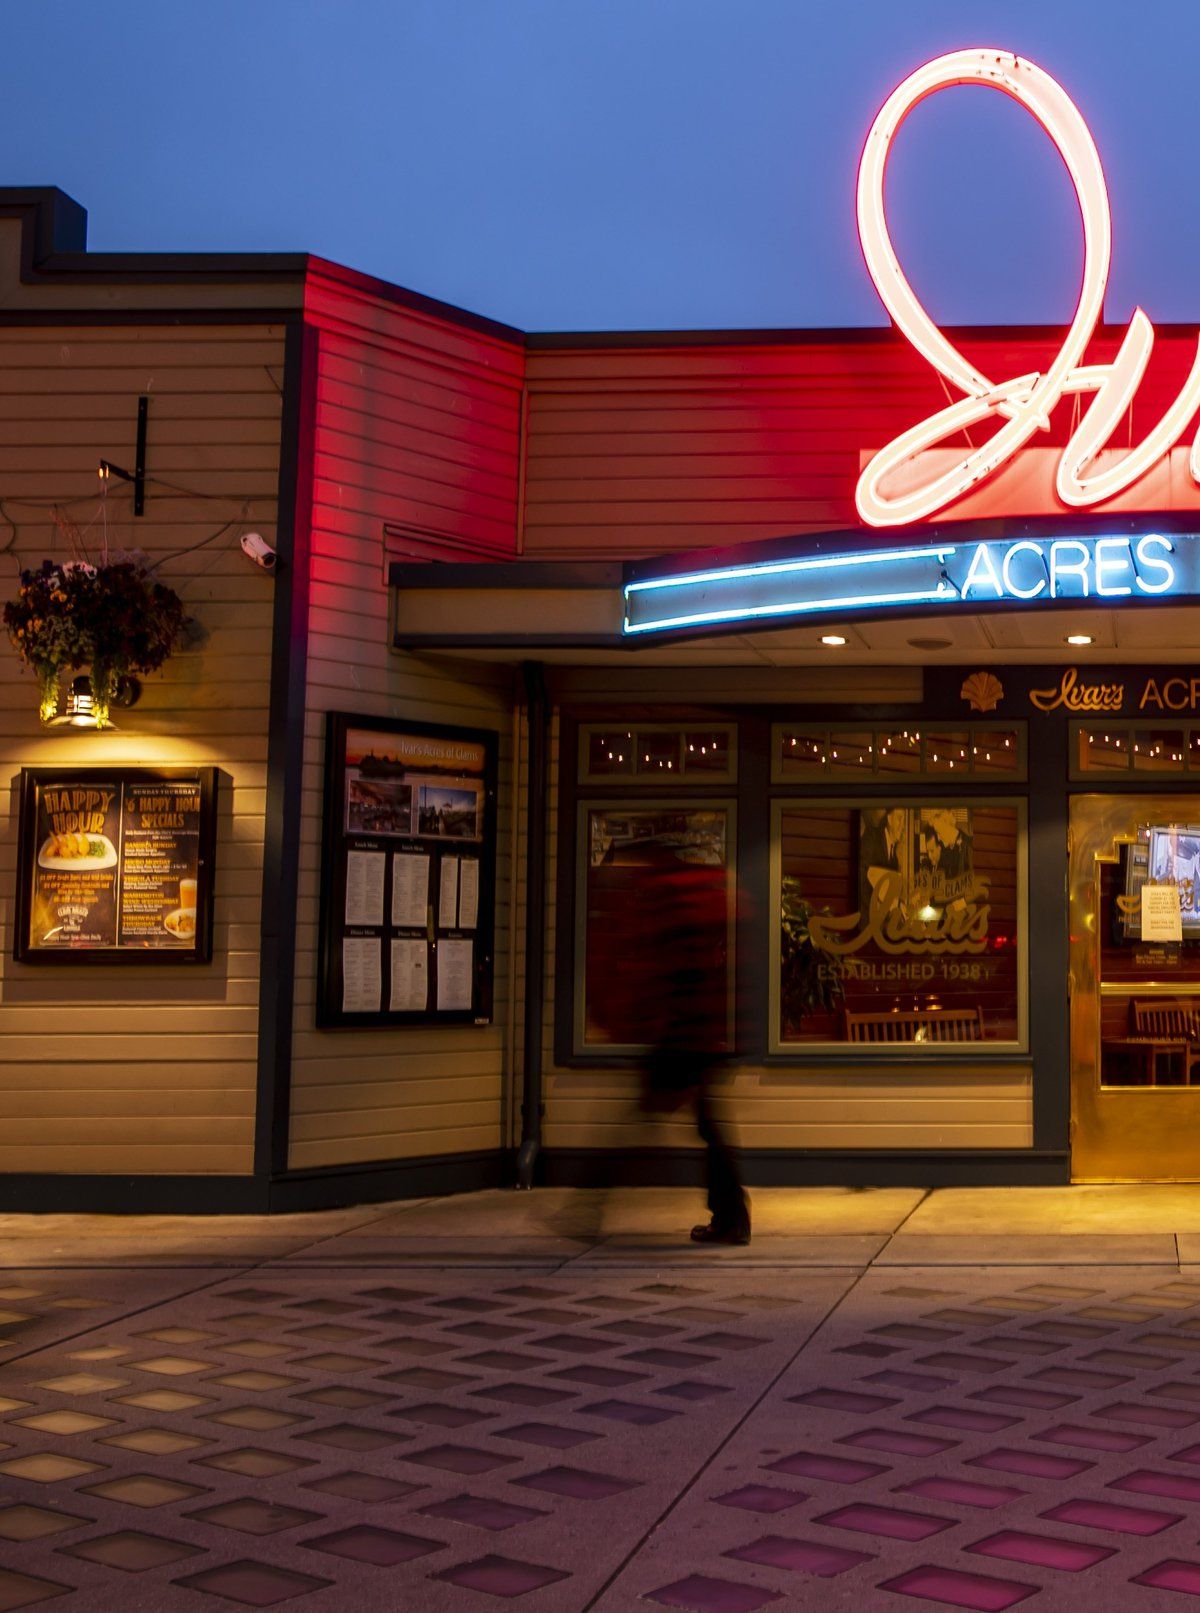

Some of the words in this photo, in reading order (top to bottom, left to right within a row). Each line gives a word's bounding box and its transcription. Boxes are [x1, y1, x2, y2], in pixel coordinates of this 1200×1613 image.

[961, 534, 1174, 599] ACRES
[423, 744, 444, 757] Acres
[455, 747, 479, 761] Clams
[44, 790, 115, 814] HAPPY
[140, 797, 172, 812] HAPPY
[52, 811, 105, 834] HOUR
[141, 813, 184, 828] SPECIALS
[817, 963, 934, 981] ESTABLISHED
